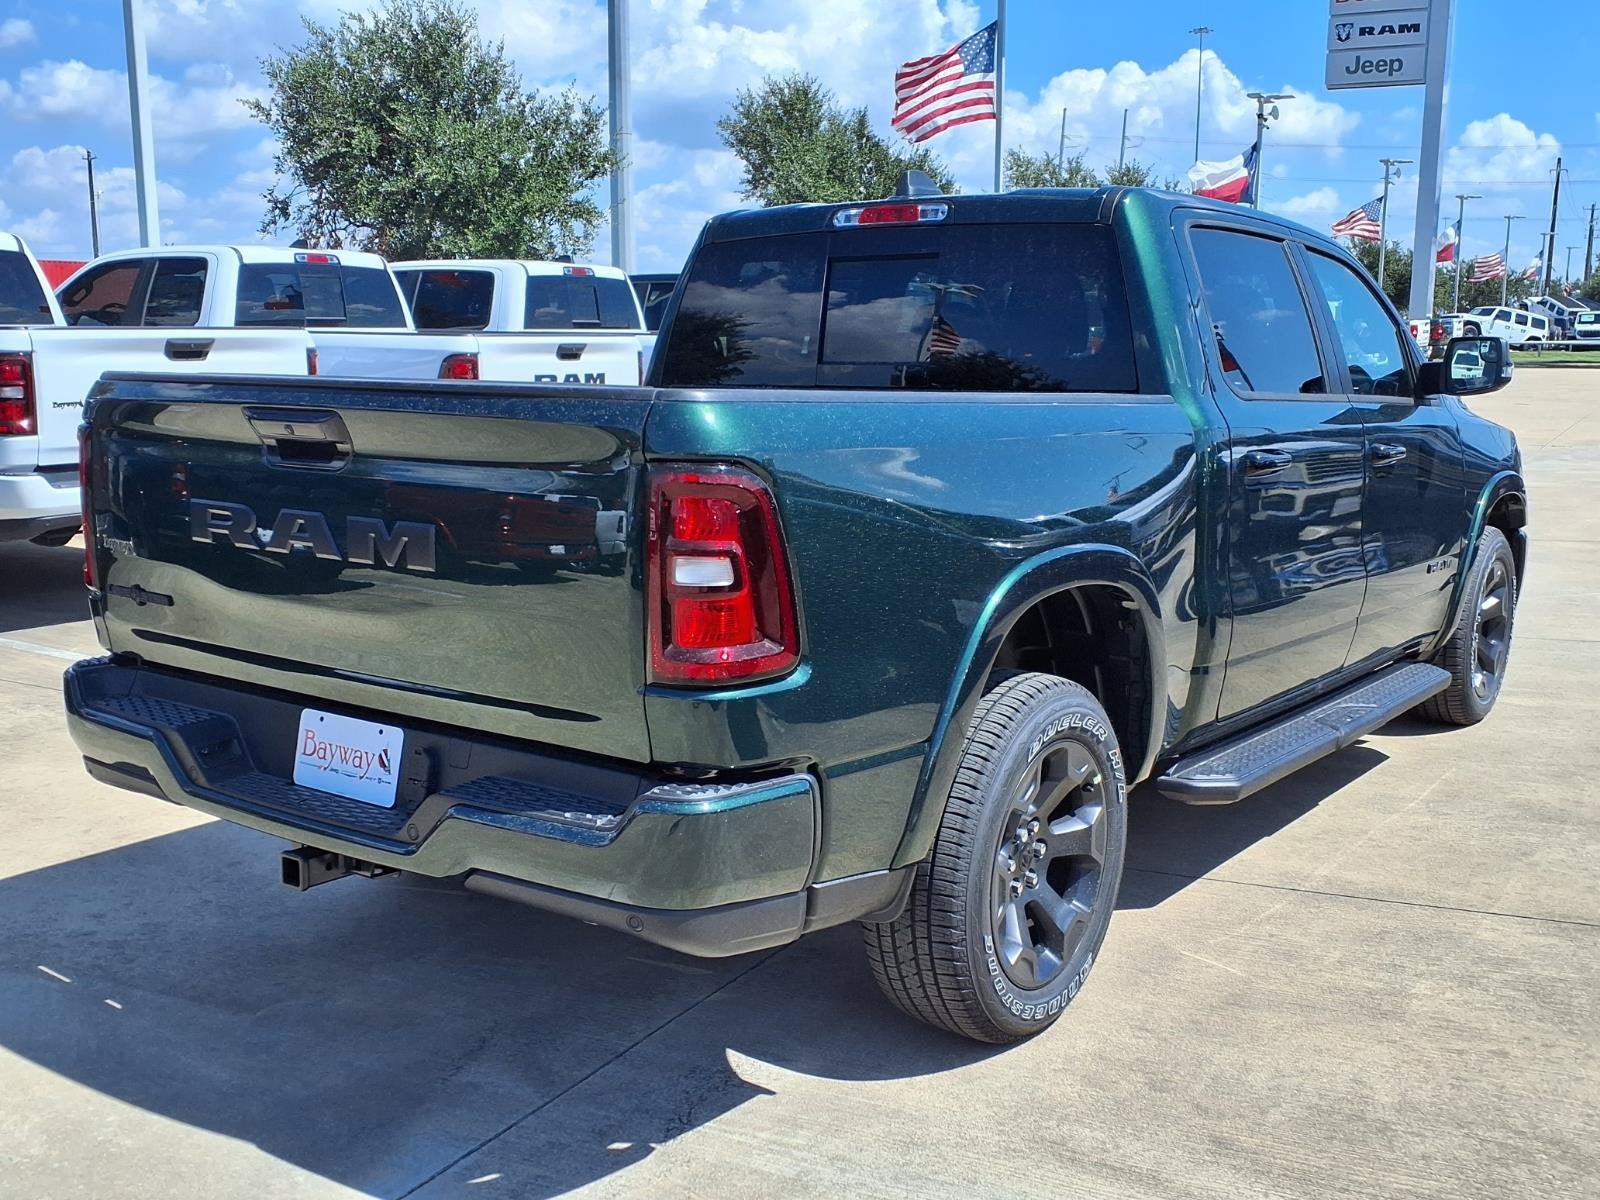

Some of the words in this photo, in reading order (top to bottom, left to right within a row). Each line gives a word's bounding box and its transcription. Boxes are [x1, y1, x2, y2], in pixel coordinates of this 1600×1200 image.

[1358, 23, 1421, 37] RAM
[1345, 55, 1404, 76] Jeep
[191, 498, 436, 572] RAM
[302, 729, 375, 780] Bayway
[983, 935, 1093, 1020] BRIDGESTONE
